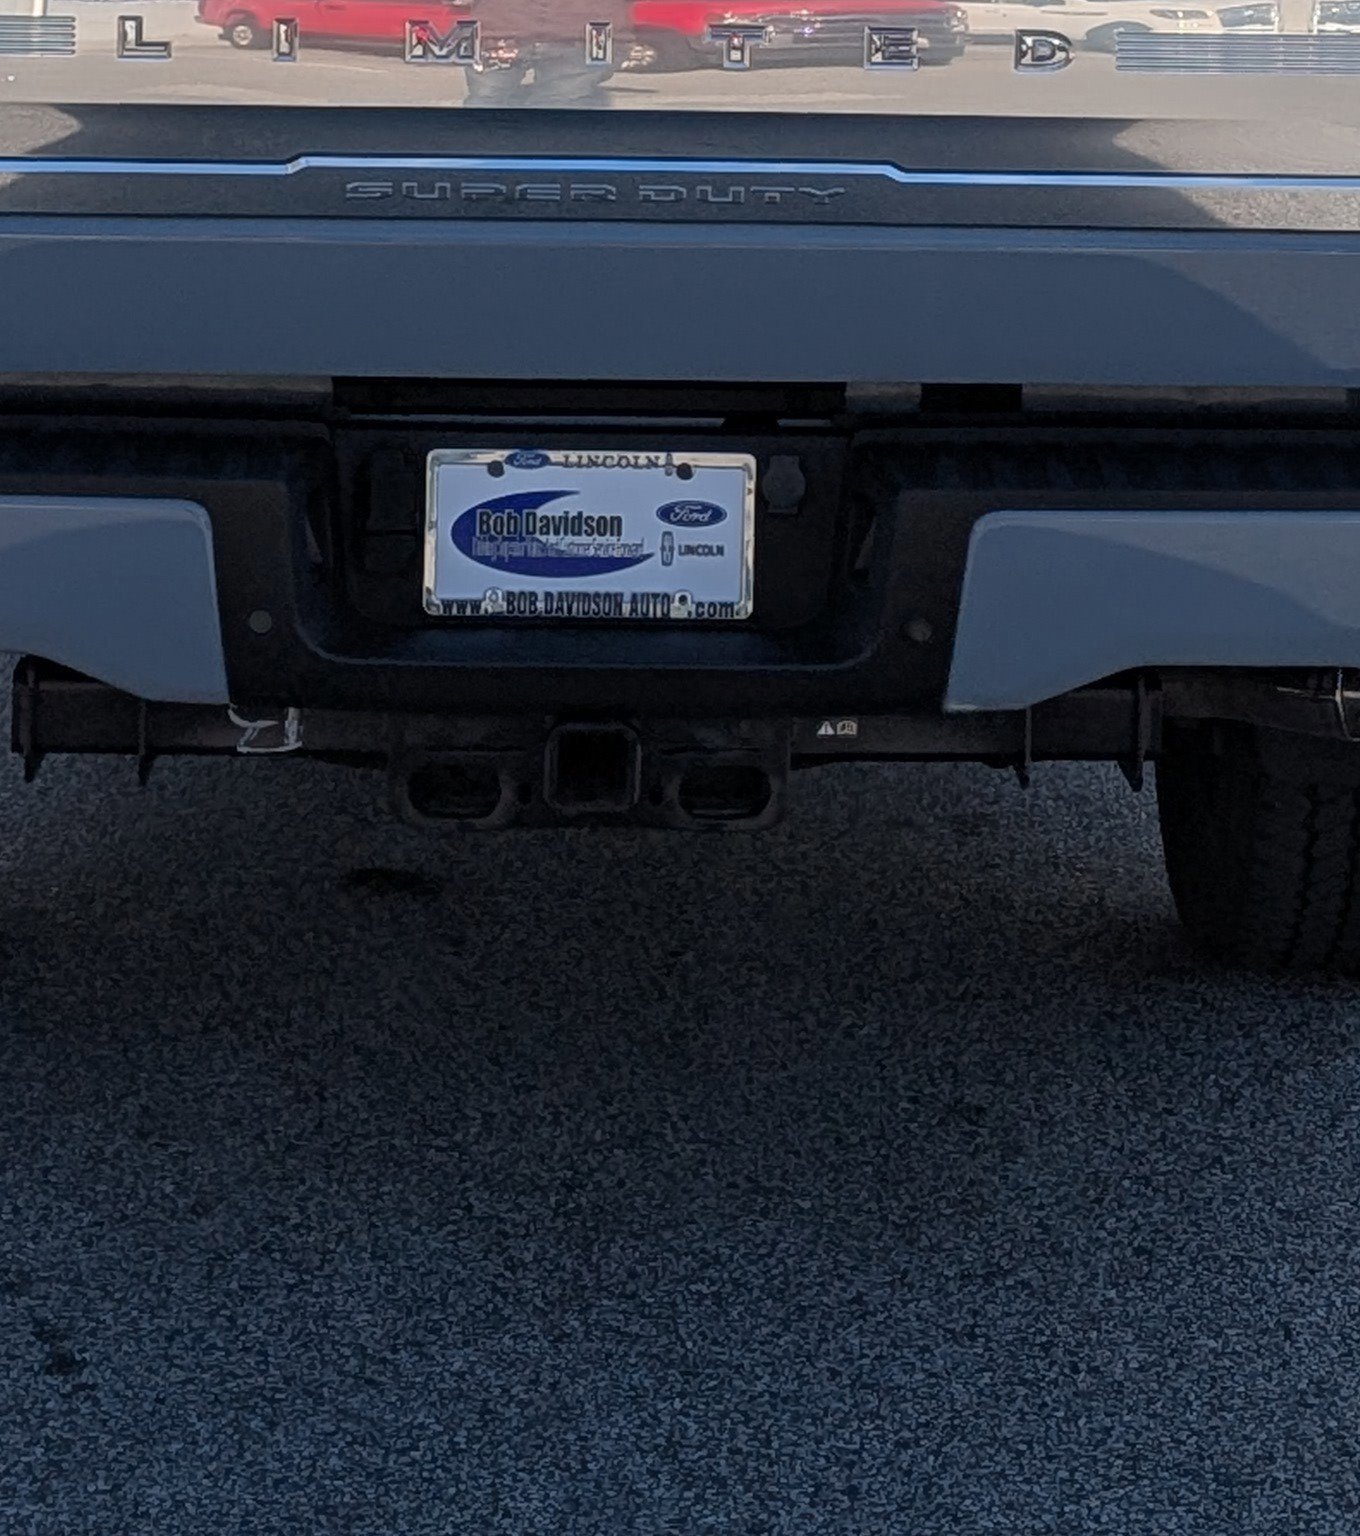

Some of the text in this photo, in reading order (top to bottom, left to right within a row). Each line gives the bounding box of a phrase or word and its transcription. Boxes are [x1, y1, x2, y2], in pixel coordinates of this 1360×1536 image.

[117, 15, 1075, 72] LIMITED
[344, 181, 846, 205] SUPER DUTY
[513, 451, 661, 470] Ford LINCOLN
[477, 510, 624, 538] Bob Davidson
[668, 504, 711, 524] Ford
[678, 543, 725, 558] LINCOLN
[506, 591, 539, 615] BOB
[543, 591, 624, 618] DAVIDSON
[629, 592, 671, 617] AUTO
